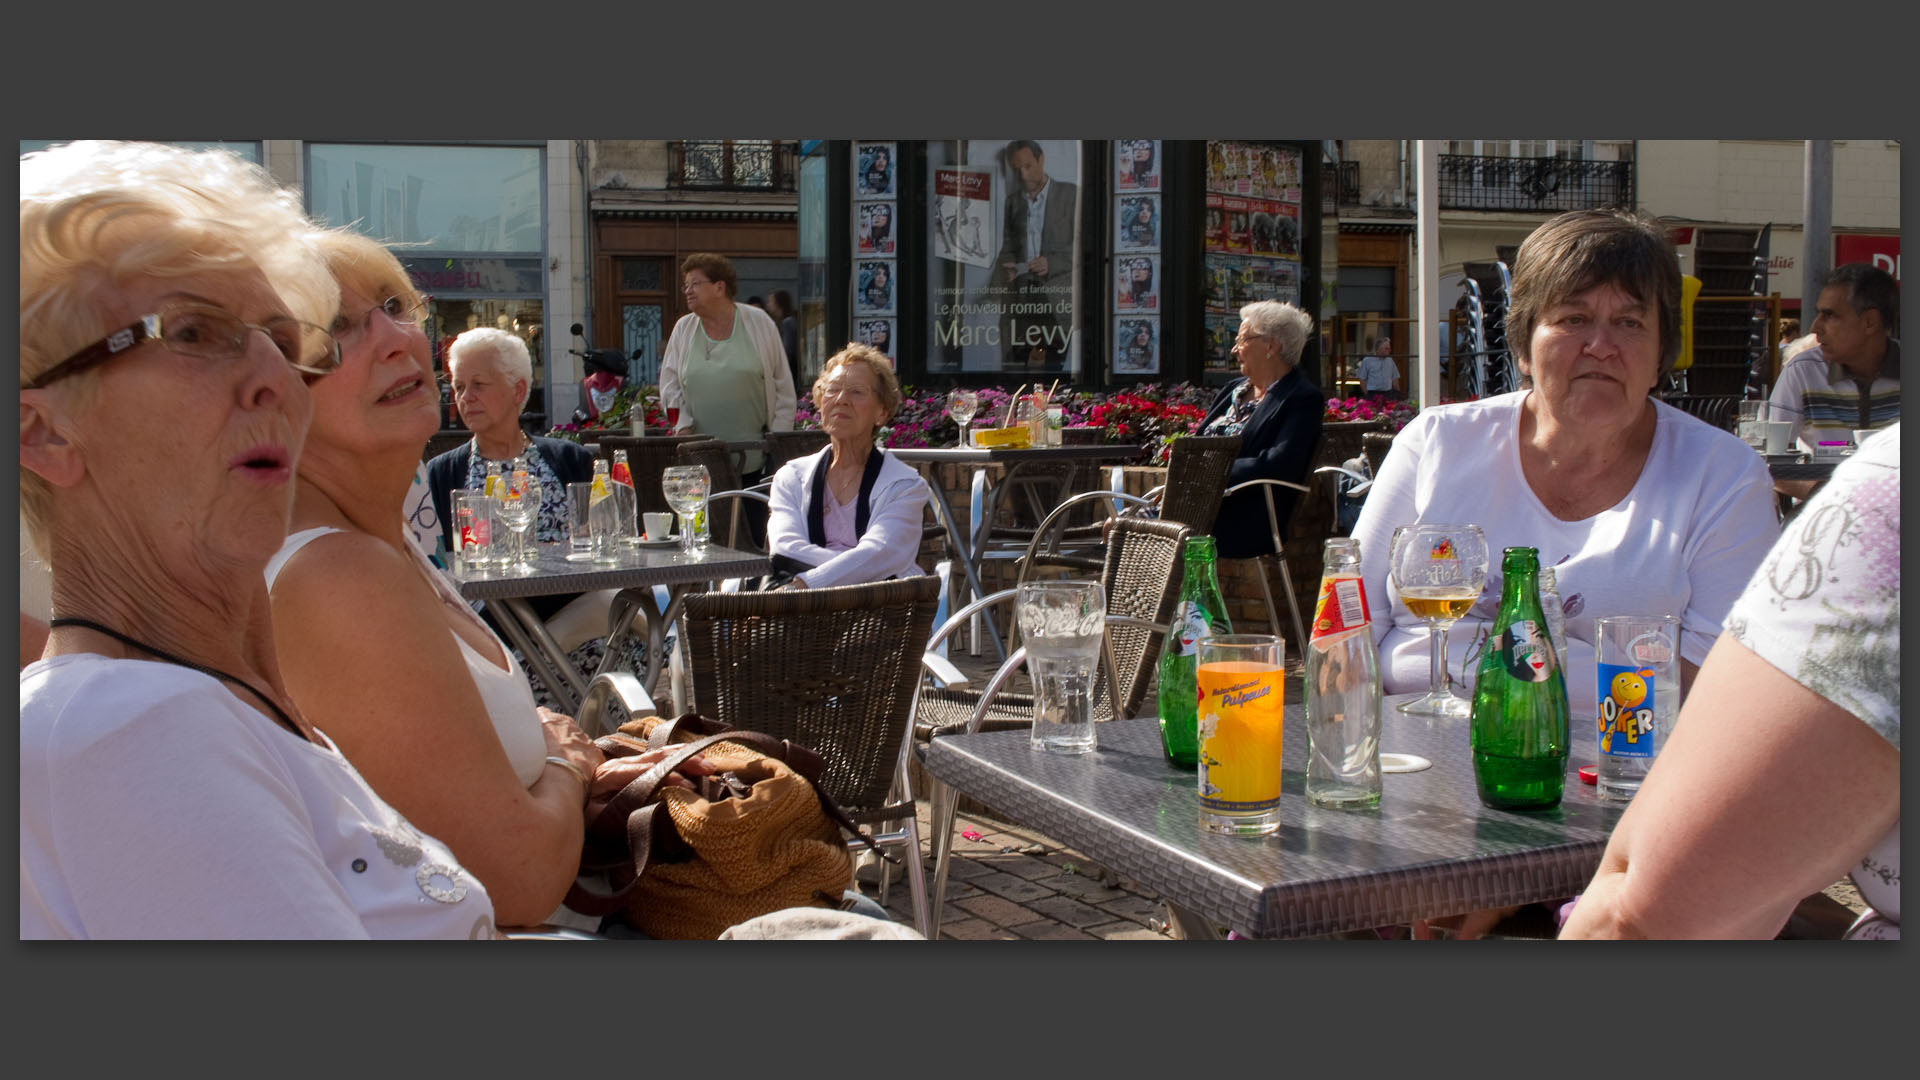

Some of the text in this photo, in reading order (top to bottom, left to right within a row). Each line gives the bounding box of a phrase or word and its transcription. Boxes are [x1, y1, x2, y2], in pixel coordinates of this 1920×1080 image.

[962, 174, 983, 189] Levy
[1767, 256, 1795, 269] alité
[1018, 285, 1028, 294] et
[1029, 284, 1074, 297] fantastique
[934, 299, 1073, 315] Le nouveau roman de
[934, 318, 1074, 354] Marc Levy
[1598, 694, 1653, 744] JOKER
